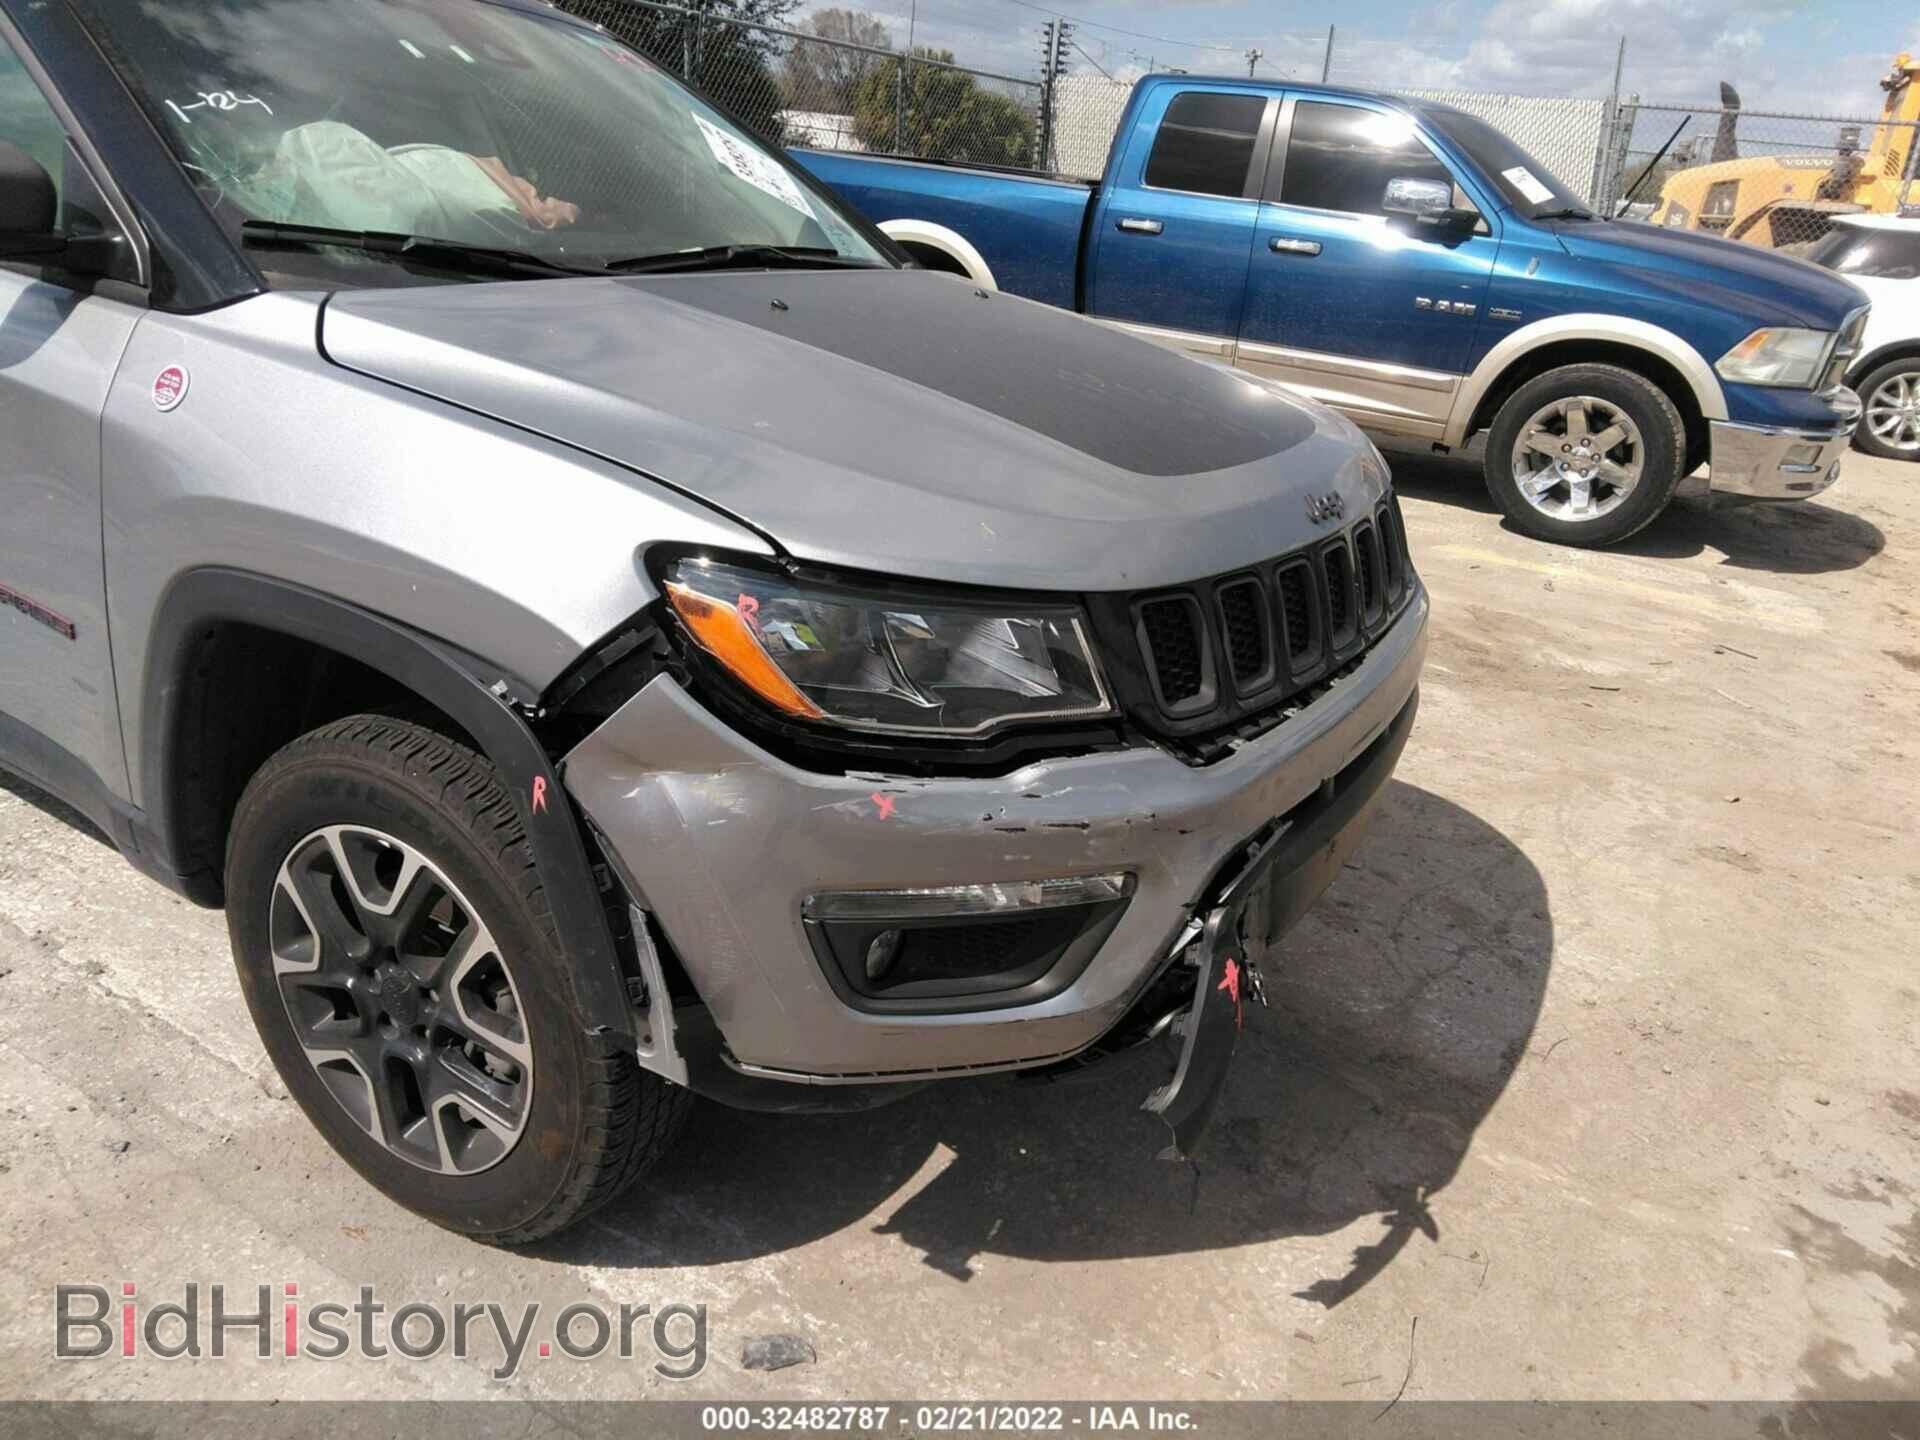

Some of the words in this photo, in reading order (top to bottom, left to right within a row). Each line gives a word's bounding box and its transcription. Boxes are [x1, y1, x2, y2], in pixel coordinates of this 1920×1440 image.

[1785, 159, 1834, 167] VOLVO
[1415, 296, 1477, 316] RAM
[532, 775, 549, 817] R
